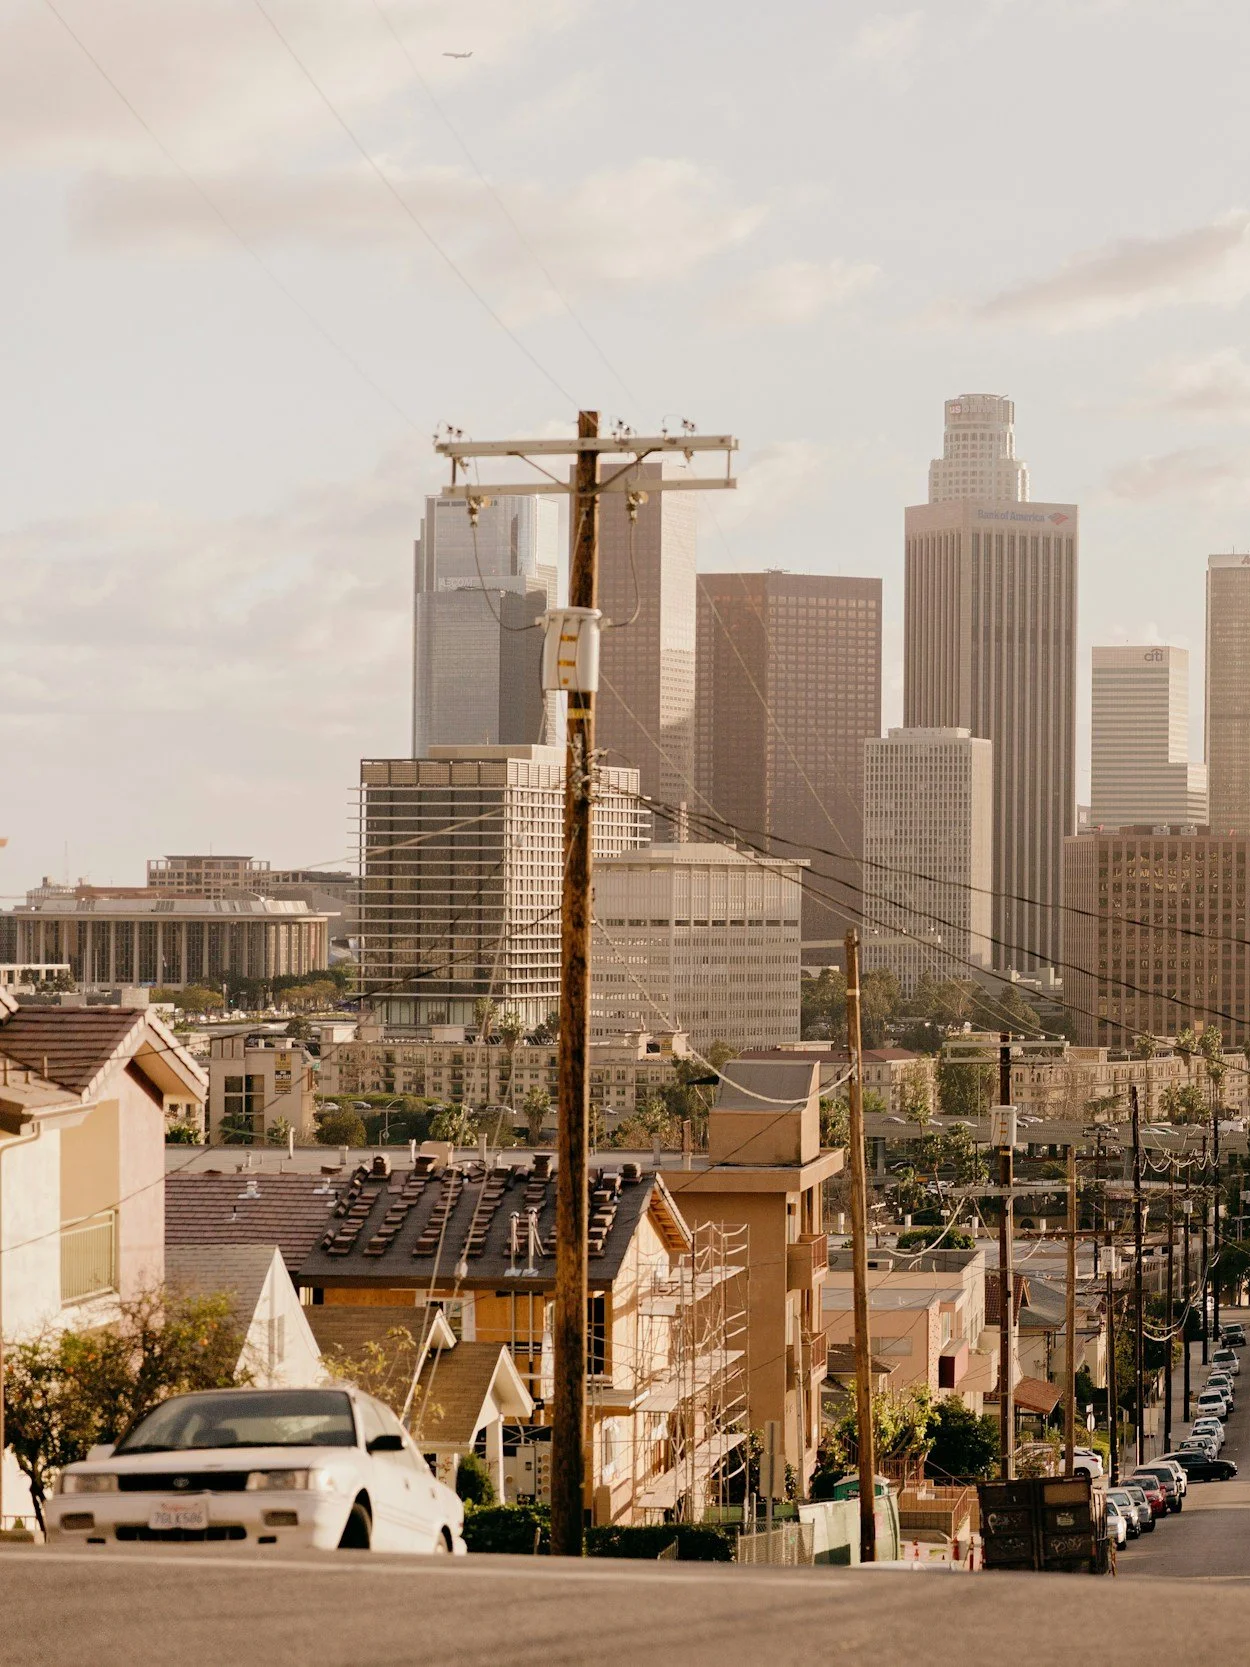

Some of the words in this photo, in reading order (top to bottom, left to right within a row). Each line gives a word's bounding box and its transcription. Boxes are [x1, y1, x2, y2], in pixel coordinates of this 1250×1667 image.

[977, 509, 999, 519] Bank
[1001, 511, 1009, 519] of
[1010, 511, 1045, 522] America
[1144, 649, 1163, 661] citi
